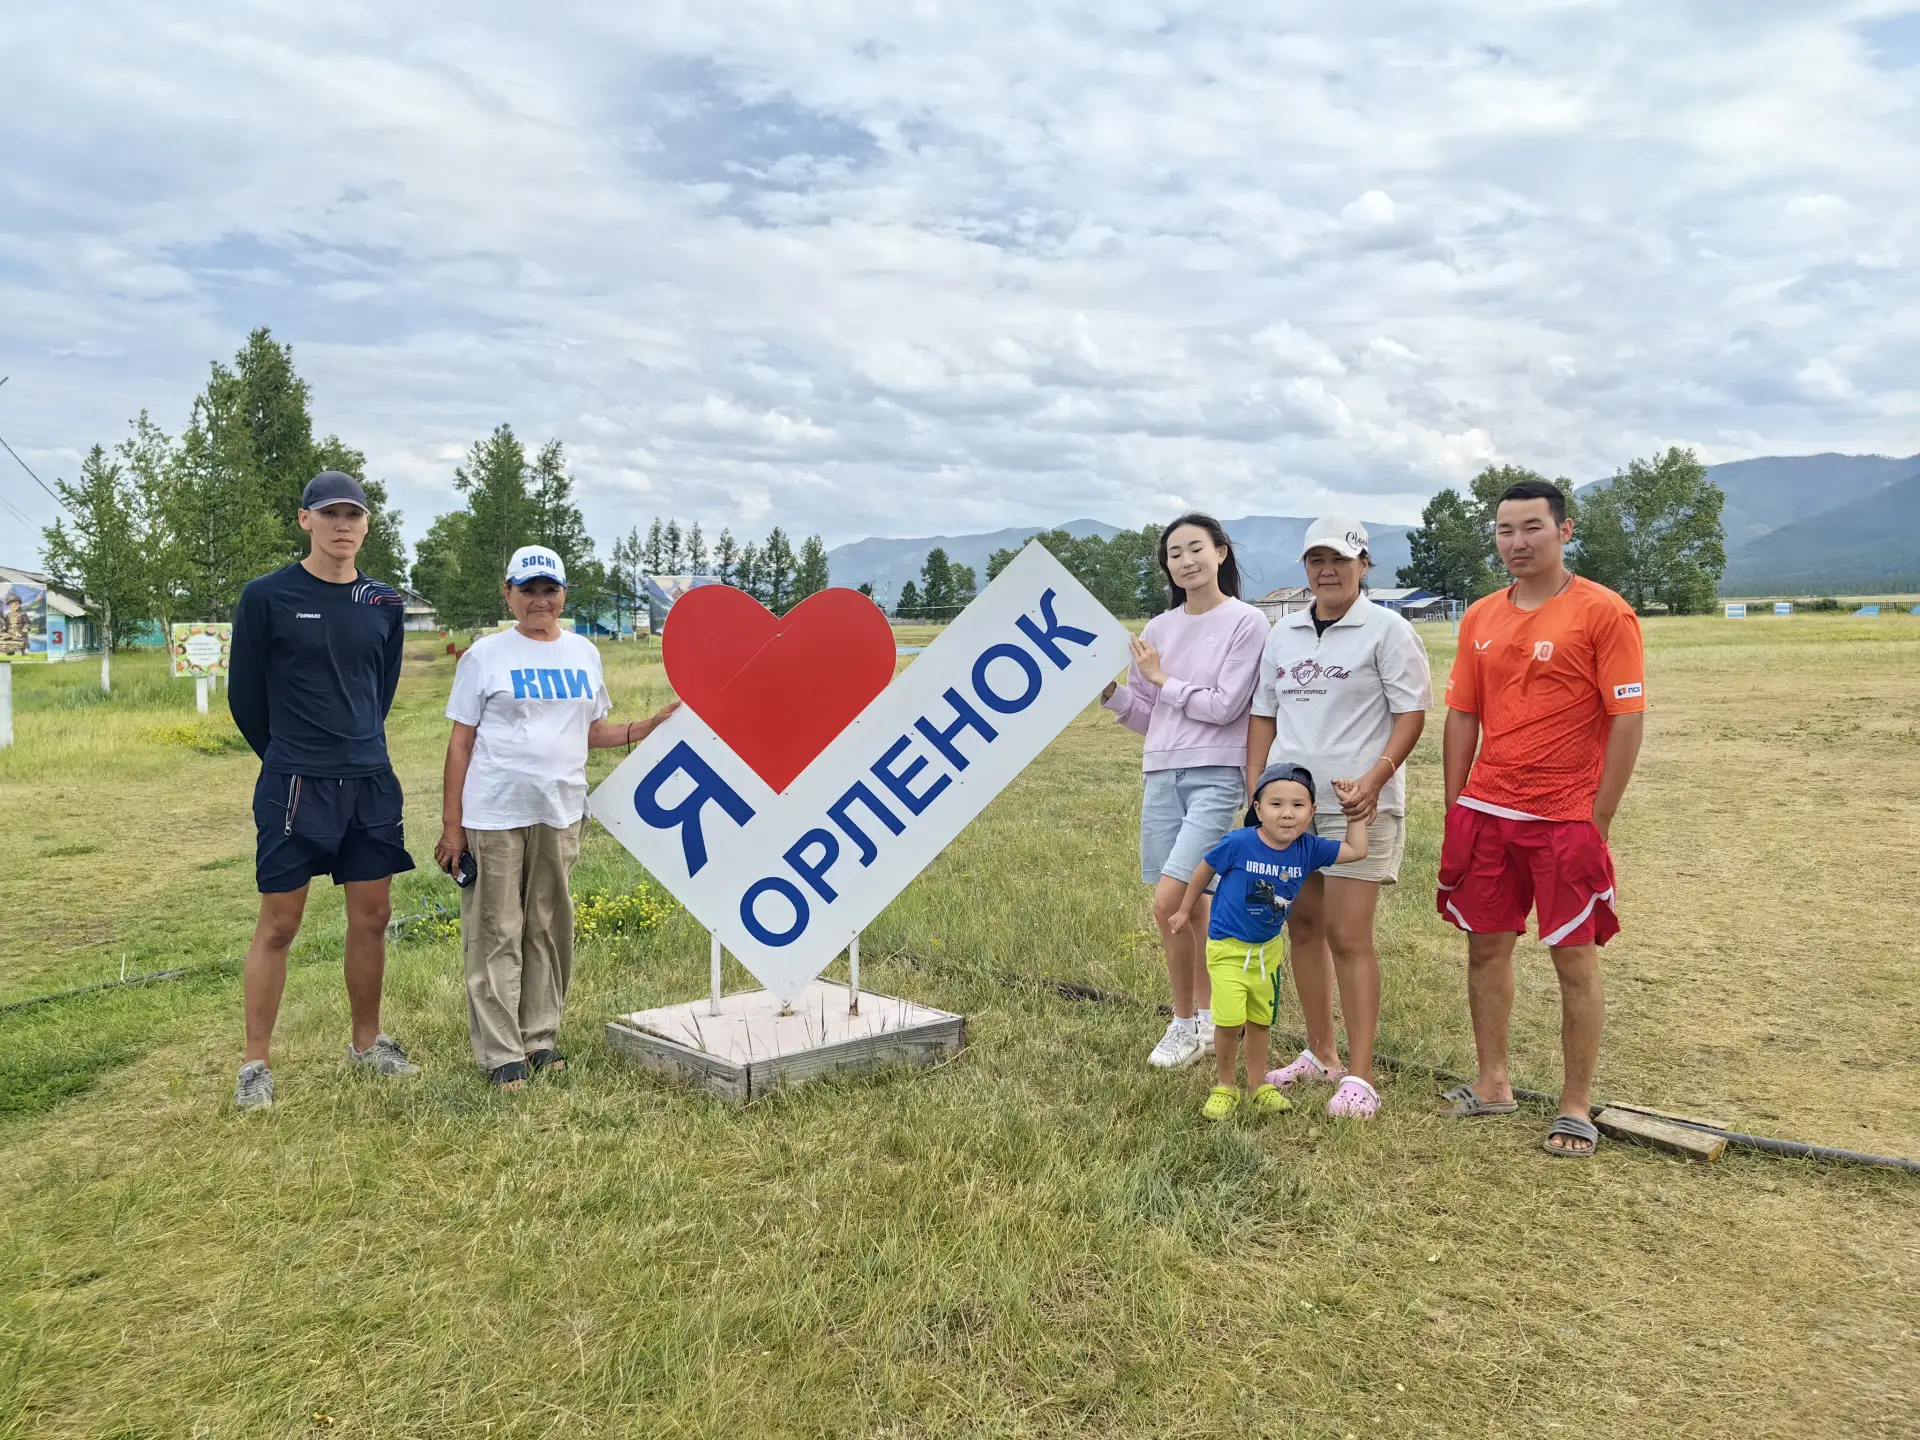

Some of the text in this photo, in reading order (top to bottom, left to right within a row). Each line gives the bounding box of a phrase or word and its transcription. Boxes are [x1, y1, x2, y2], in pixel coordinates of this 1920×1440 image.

[521, 555, 556, 570] SOCHI
[52, 631, 63, 645] 3
[510, 668, 593, 700] КПИ
[739, 587, 1099, 947] ОРЛЕНОК
[633, 739, 757, 879] Я
[1246, 860, 1279, 876] URBAN
